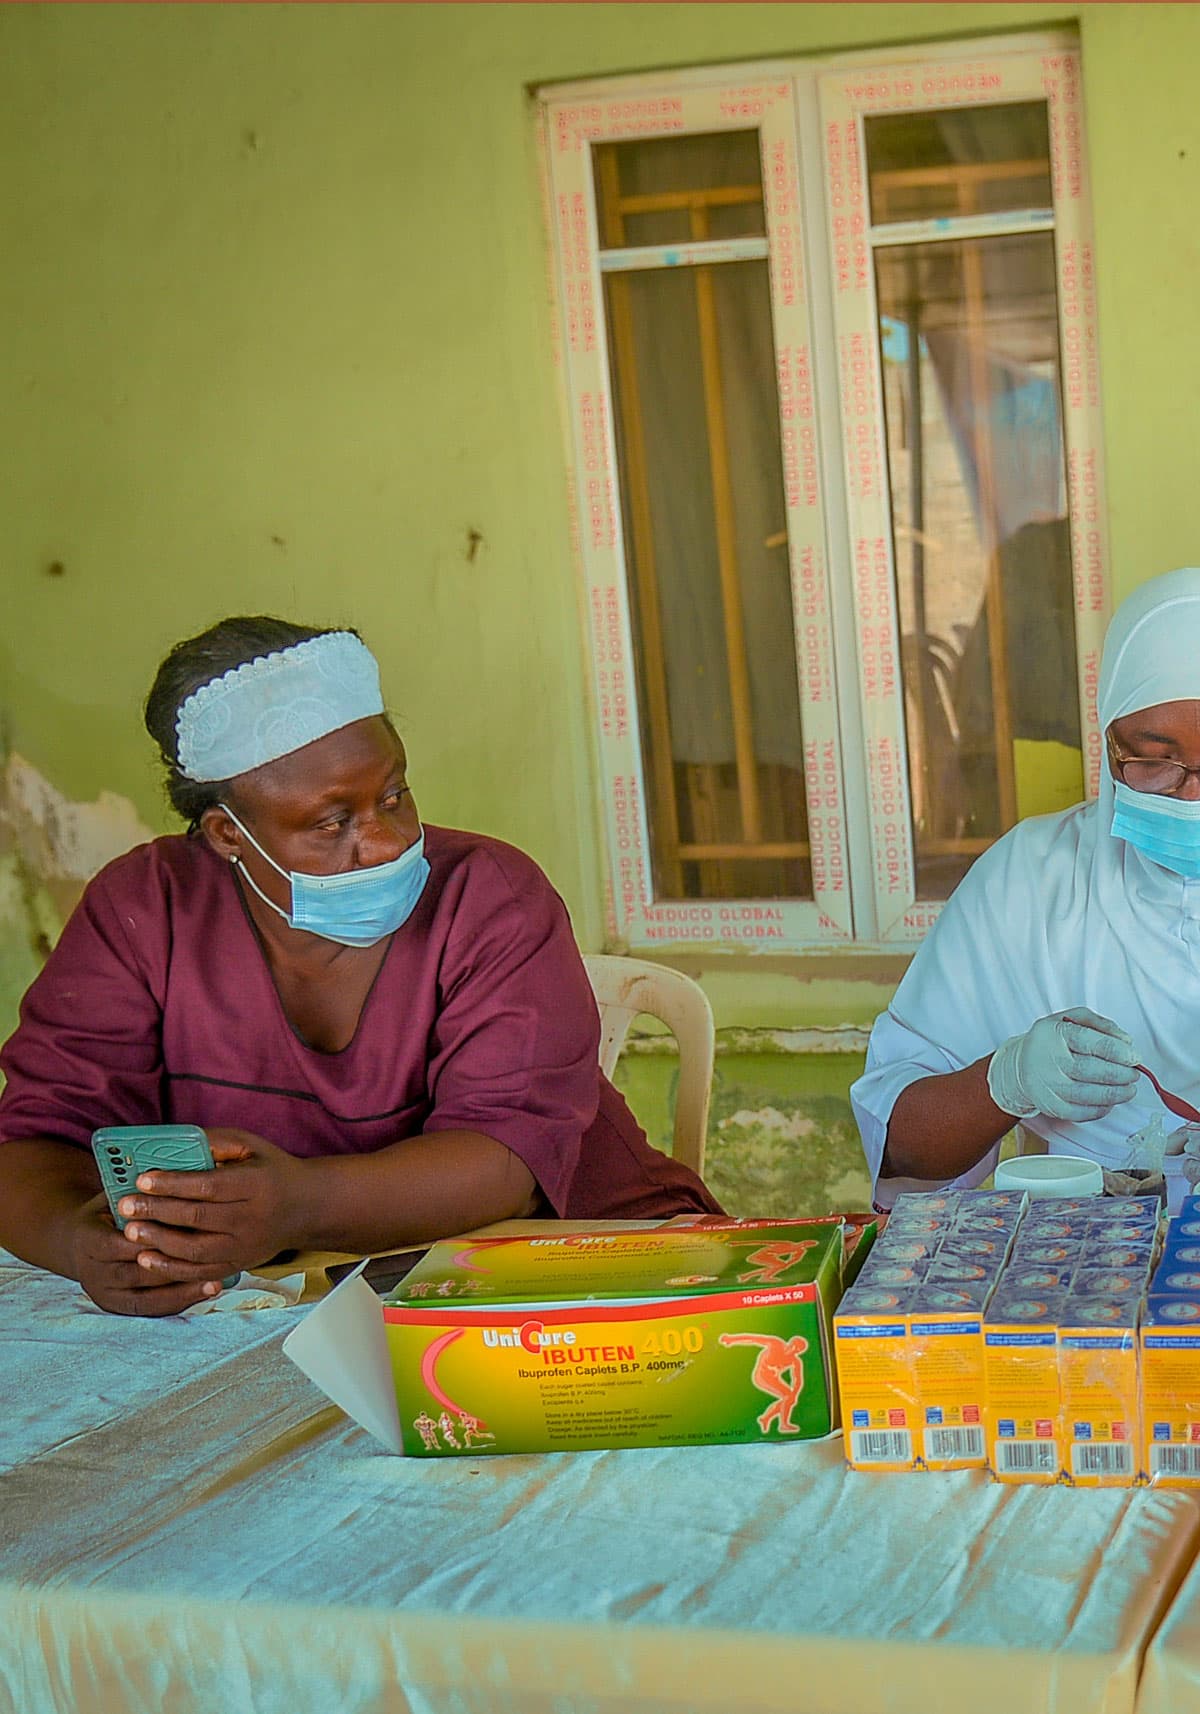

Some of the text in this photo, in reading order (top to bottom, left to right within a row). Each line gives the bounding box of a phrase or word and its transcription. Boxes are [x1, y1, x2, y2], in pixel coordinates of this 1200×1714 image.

[1085, 650, 1103, 797] EDUCO GLOBAL
[806, 740, 826, 891] NEDUCO GLOBAL
[823, 740, 843, 891] NEDUCO GLOBAL
[879, 737, 899, 894] NEDUCO GLOBAL
[645, 925, 784, 938] NEDUCO GLOBAL
[719, 907, 784, 921] GLOBAL
[742, 1296, 753, 1304] 10
[754, 1293, 784, 1305] Caplets
[482, 1321, 577, 1354] UniCure
[542, 1326, 704, 1365] IBUTEN 400
[518, 1368, 572, 1379] Ibuprofen
[575, 1365, 617, 1377] Caplets
[620, 1363, 643, 1373] B.P.
